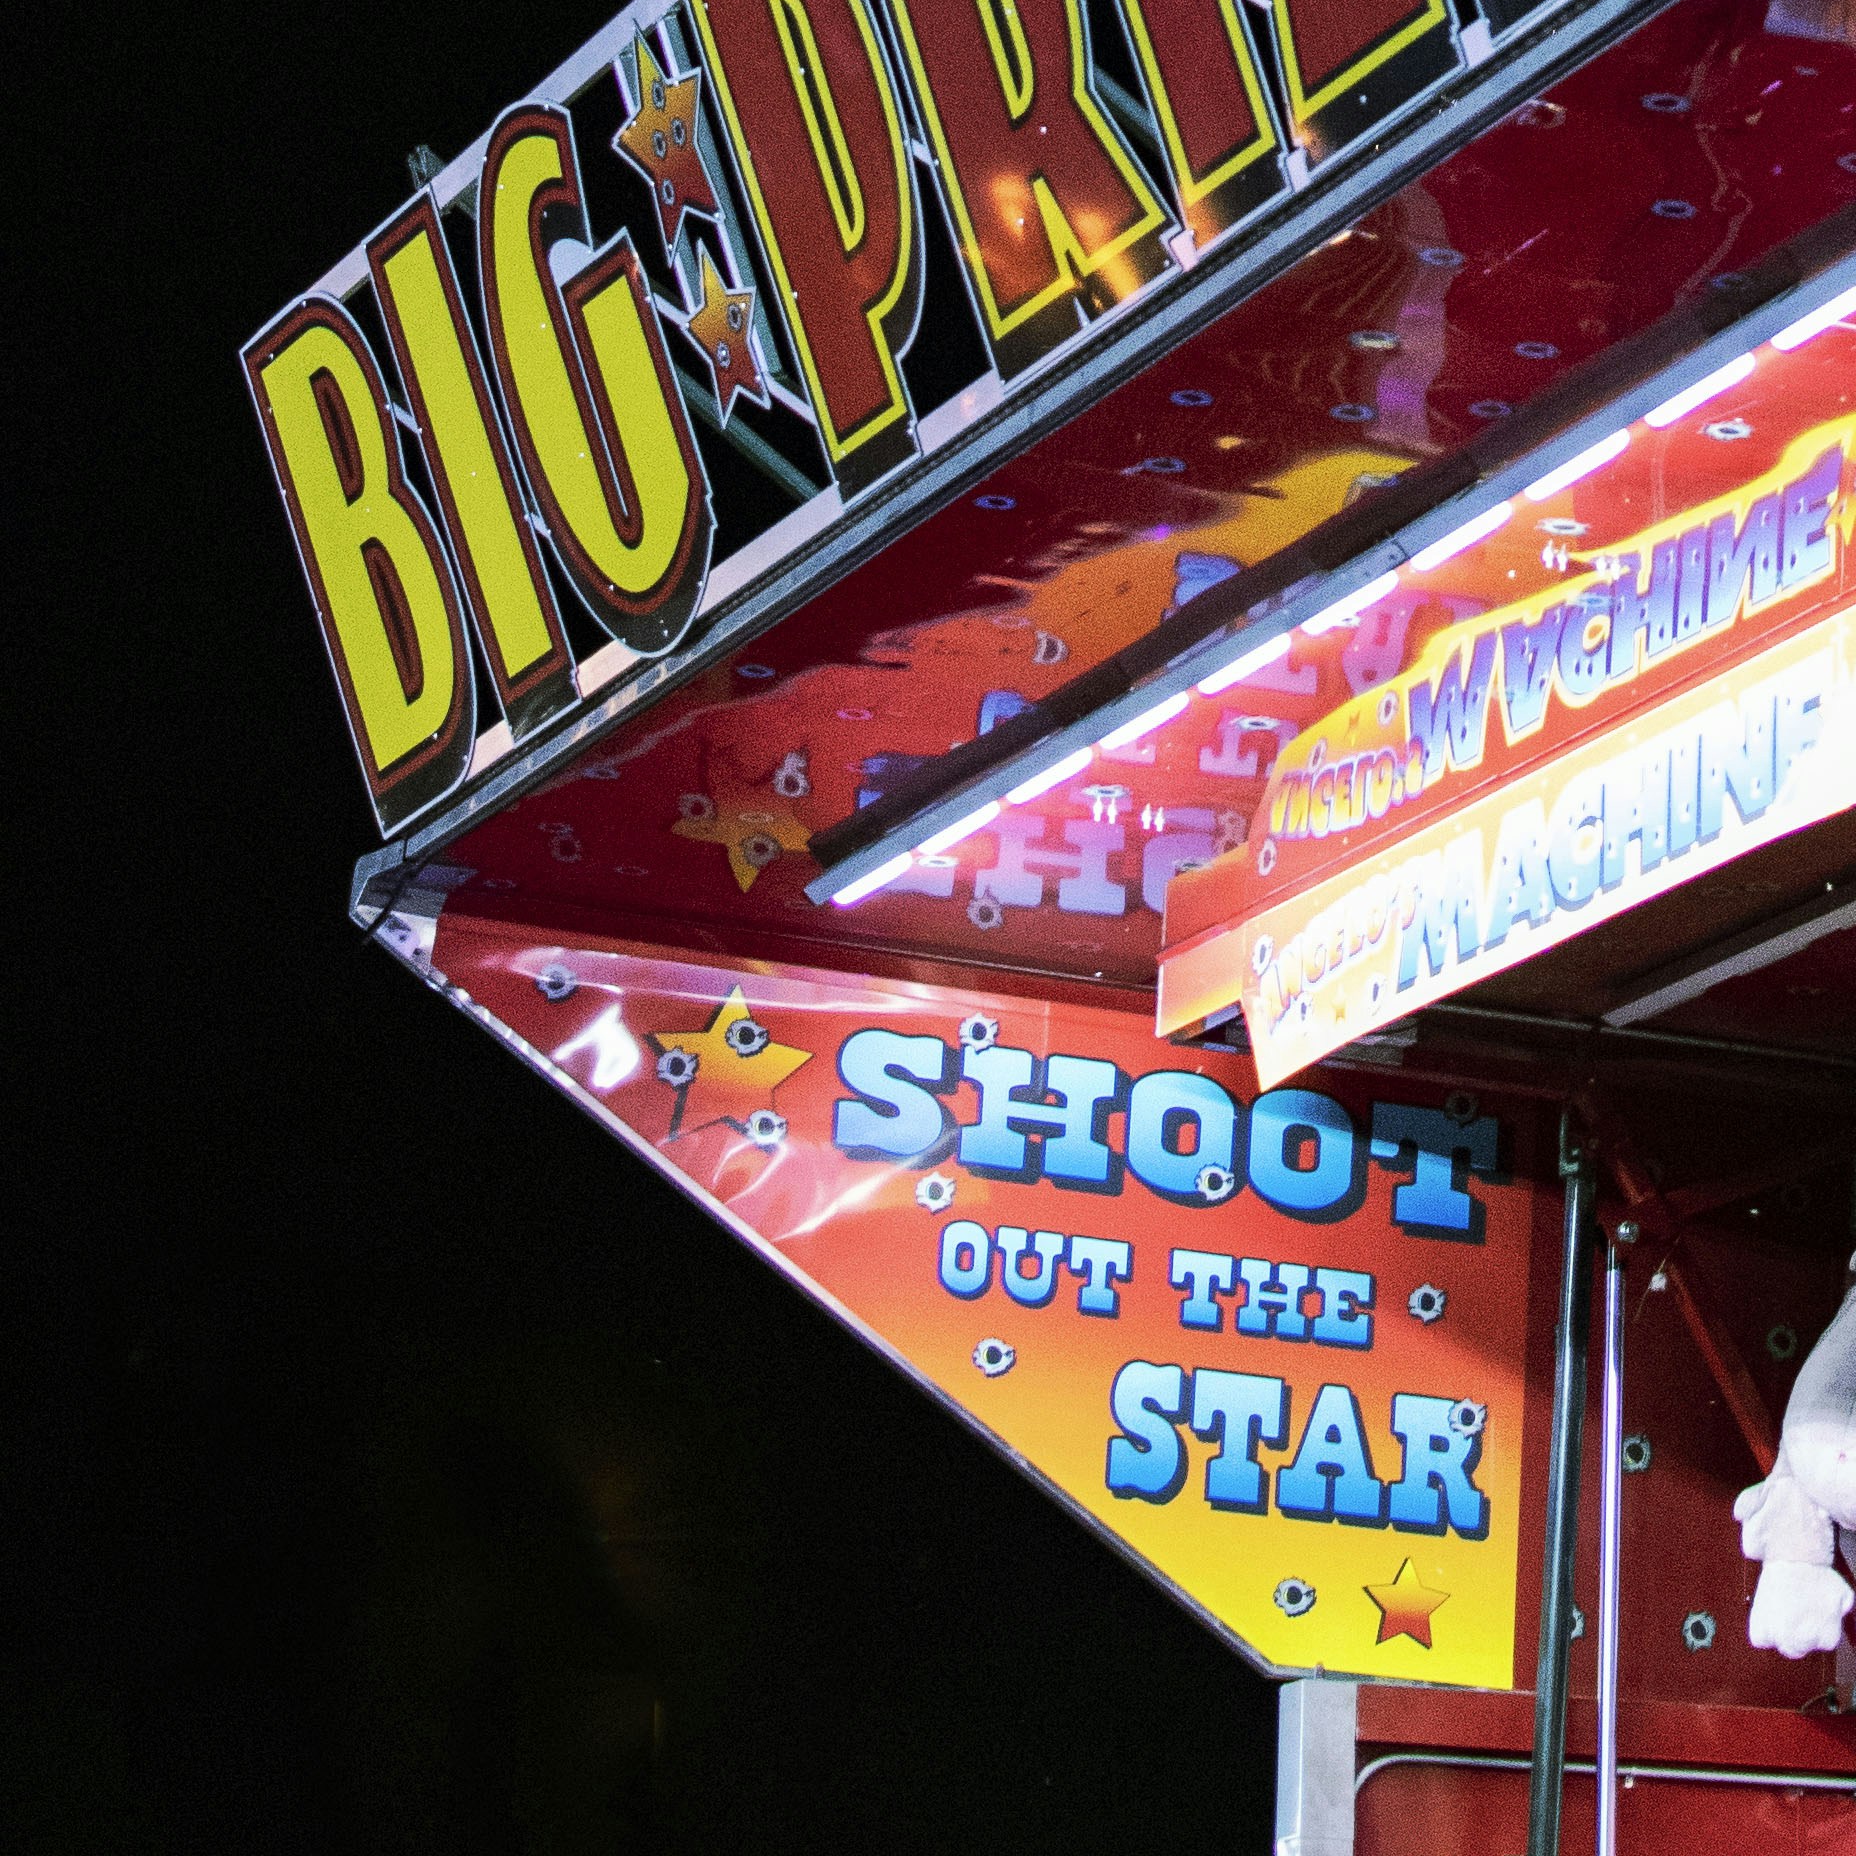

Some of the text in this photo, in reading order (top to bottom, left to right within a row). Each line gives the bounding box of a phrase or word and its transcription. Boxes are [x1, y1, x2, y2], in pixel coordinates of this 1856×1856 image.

[244, 108, 713, 833] BIG
[1396, 688, 1828, 993] MACHINE
[833, 1028, 1510, 1243] SHOOT
[937, 1219, 1376, 1349] OUT THE
[1105, 1358, 1491, 1541] STAR
